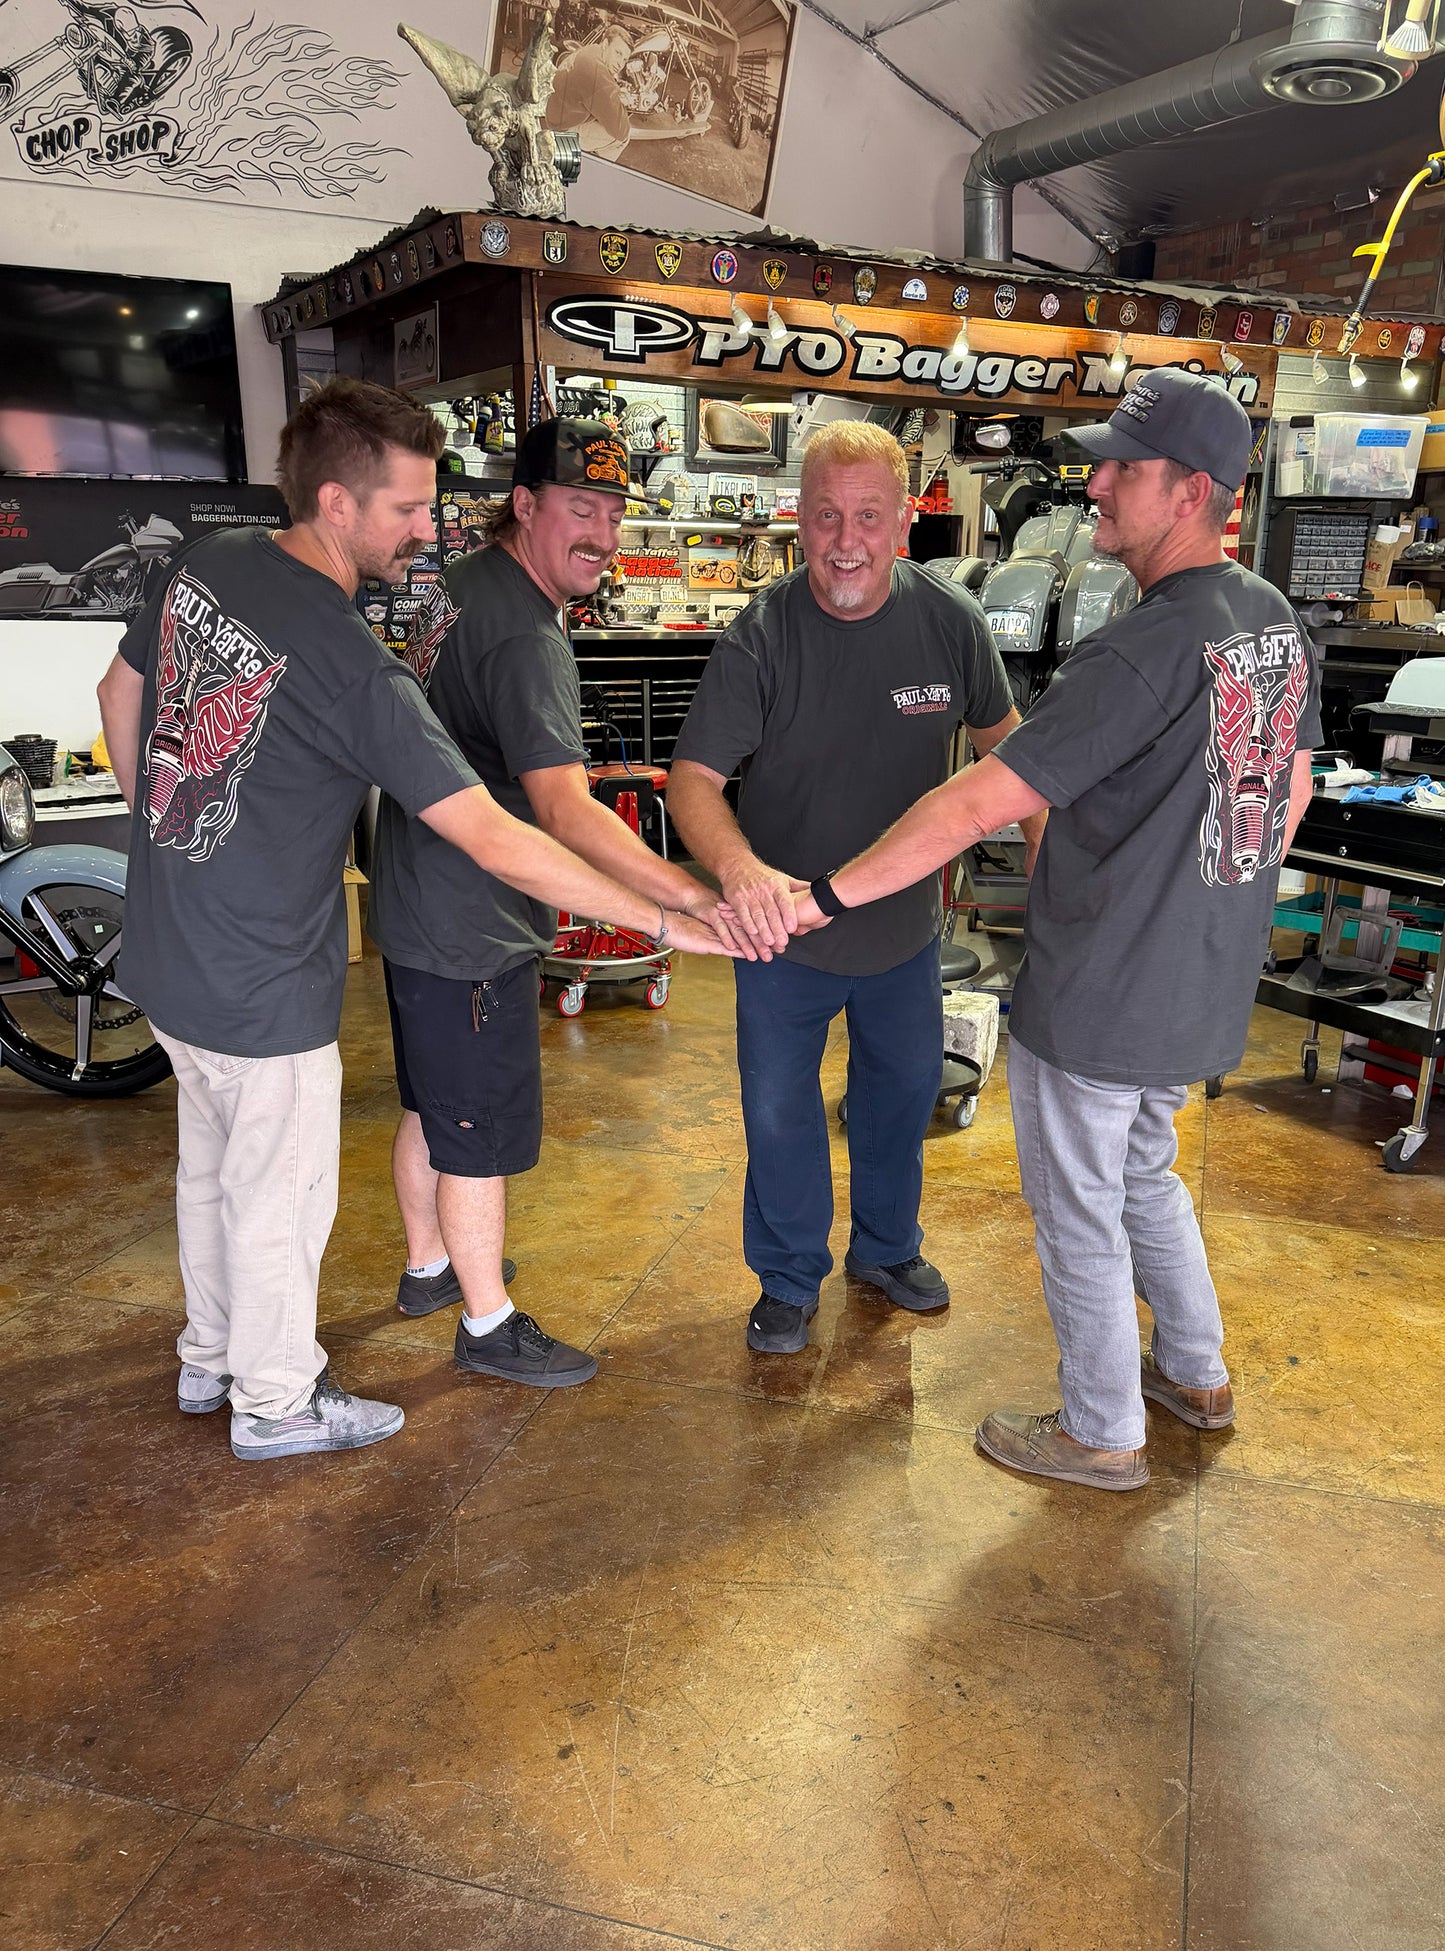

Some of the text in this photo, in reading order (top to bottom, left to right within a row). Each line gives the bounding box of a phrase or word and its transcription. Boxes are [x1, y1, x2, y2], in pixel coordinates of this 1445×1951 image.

[26, 118, 171, 161] CHOP SHOP
[698, 321, 844, 371] PYO
[855, 336, 1074, 393] Bagger
[585, 440, 608, 454] PAUL
[190, 503, 236, 513] SHOP NOW!
[191, 513, 281, 524] BAGGERNATION.COM
[615, 547, 640, 557] Paul
[615, 554, 679, 568] Bagger
[624, 565, 683, 578] Nation
[170, 581, 213, 637] PAUL
[395, 600, 421, 610] COM
[893, 689, 925, 709] PAUL
[901, 701, 948, 715] ORIGINALS
